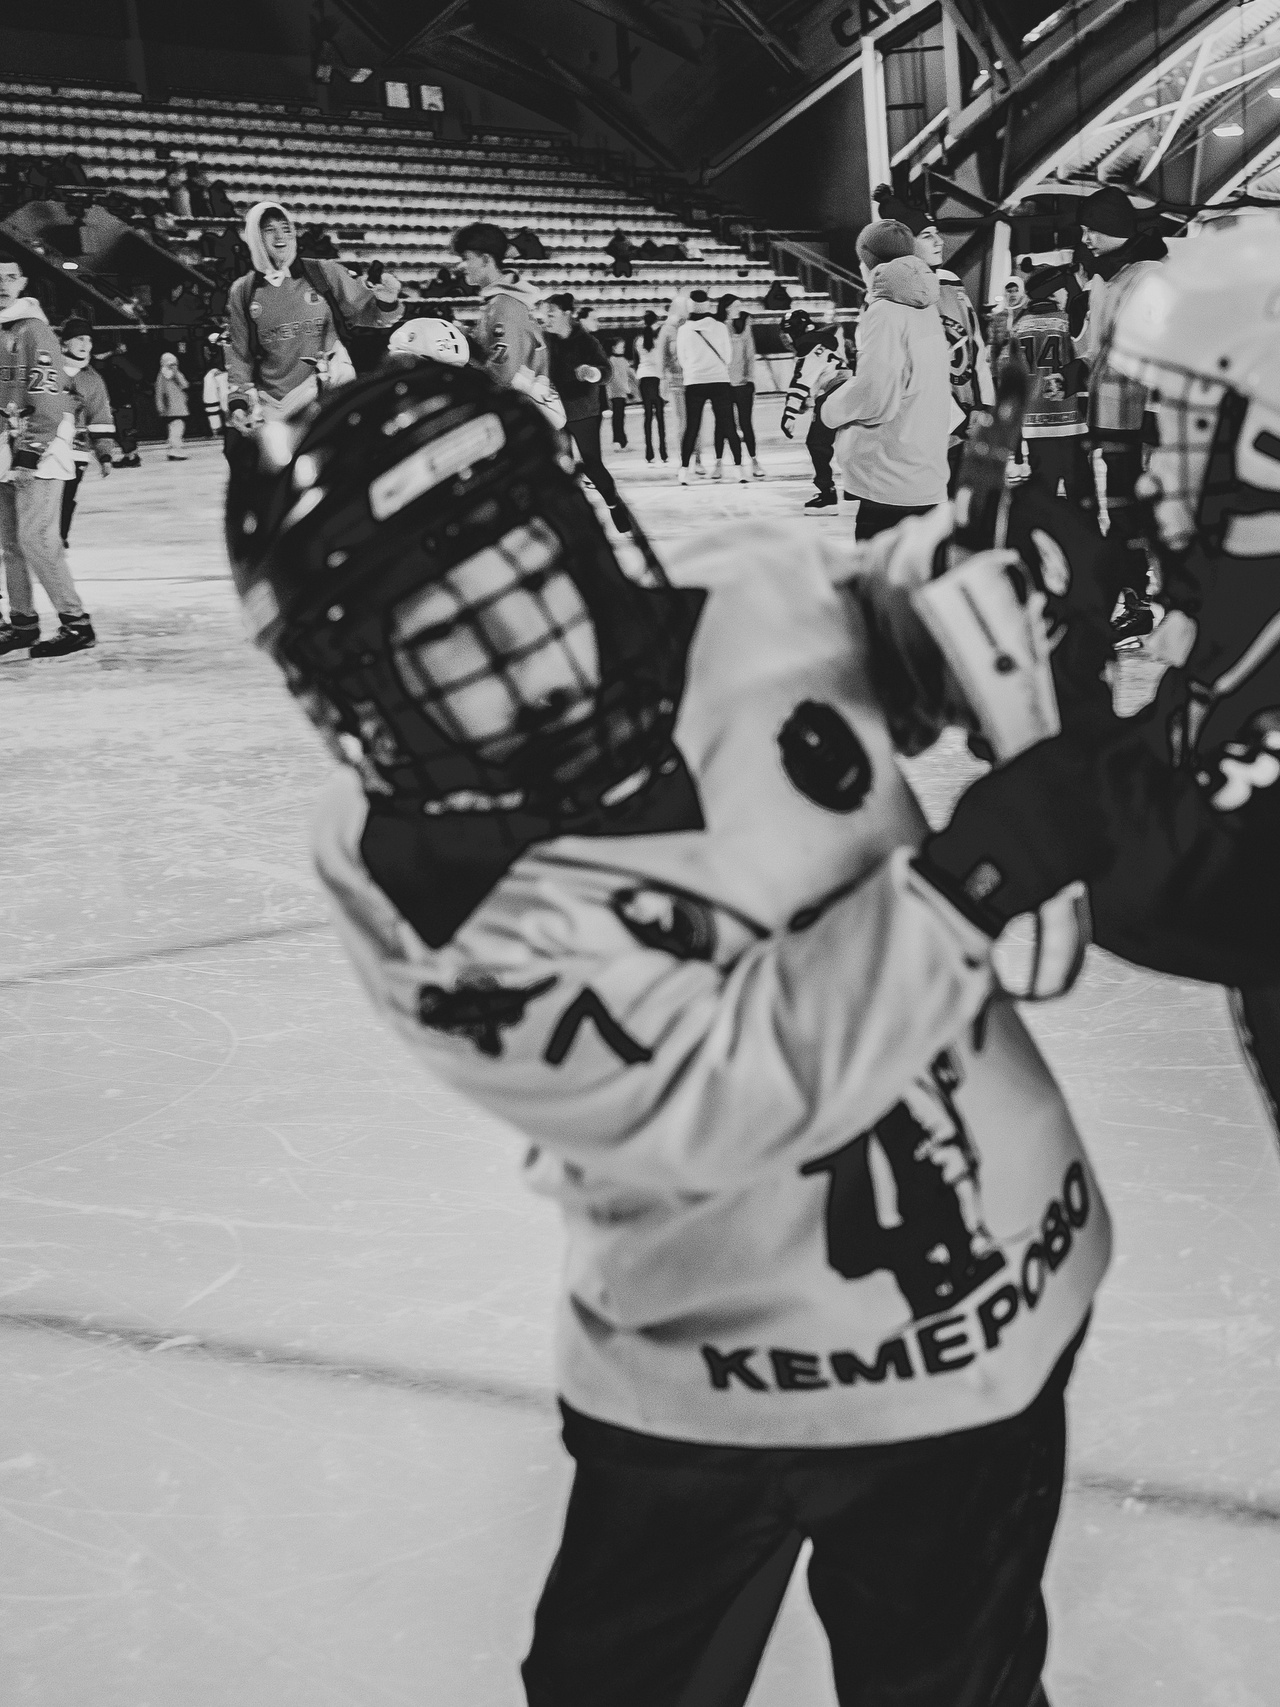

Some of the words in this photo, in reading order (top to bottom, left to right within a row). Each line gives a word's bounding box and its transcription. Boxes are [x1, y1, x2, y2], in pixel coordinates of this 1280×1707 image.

[1019, 334, 1064, 375] 14
[28, 367, 59, 394] 25
[702, 1162, 1091, 1392] КЕМЕРОВО
